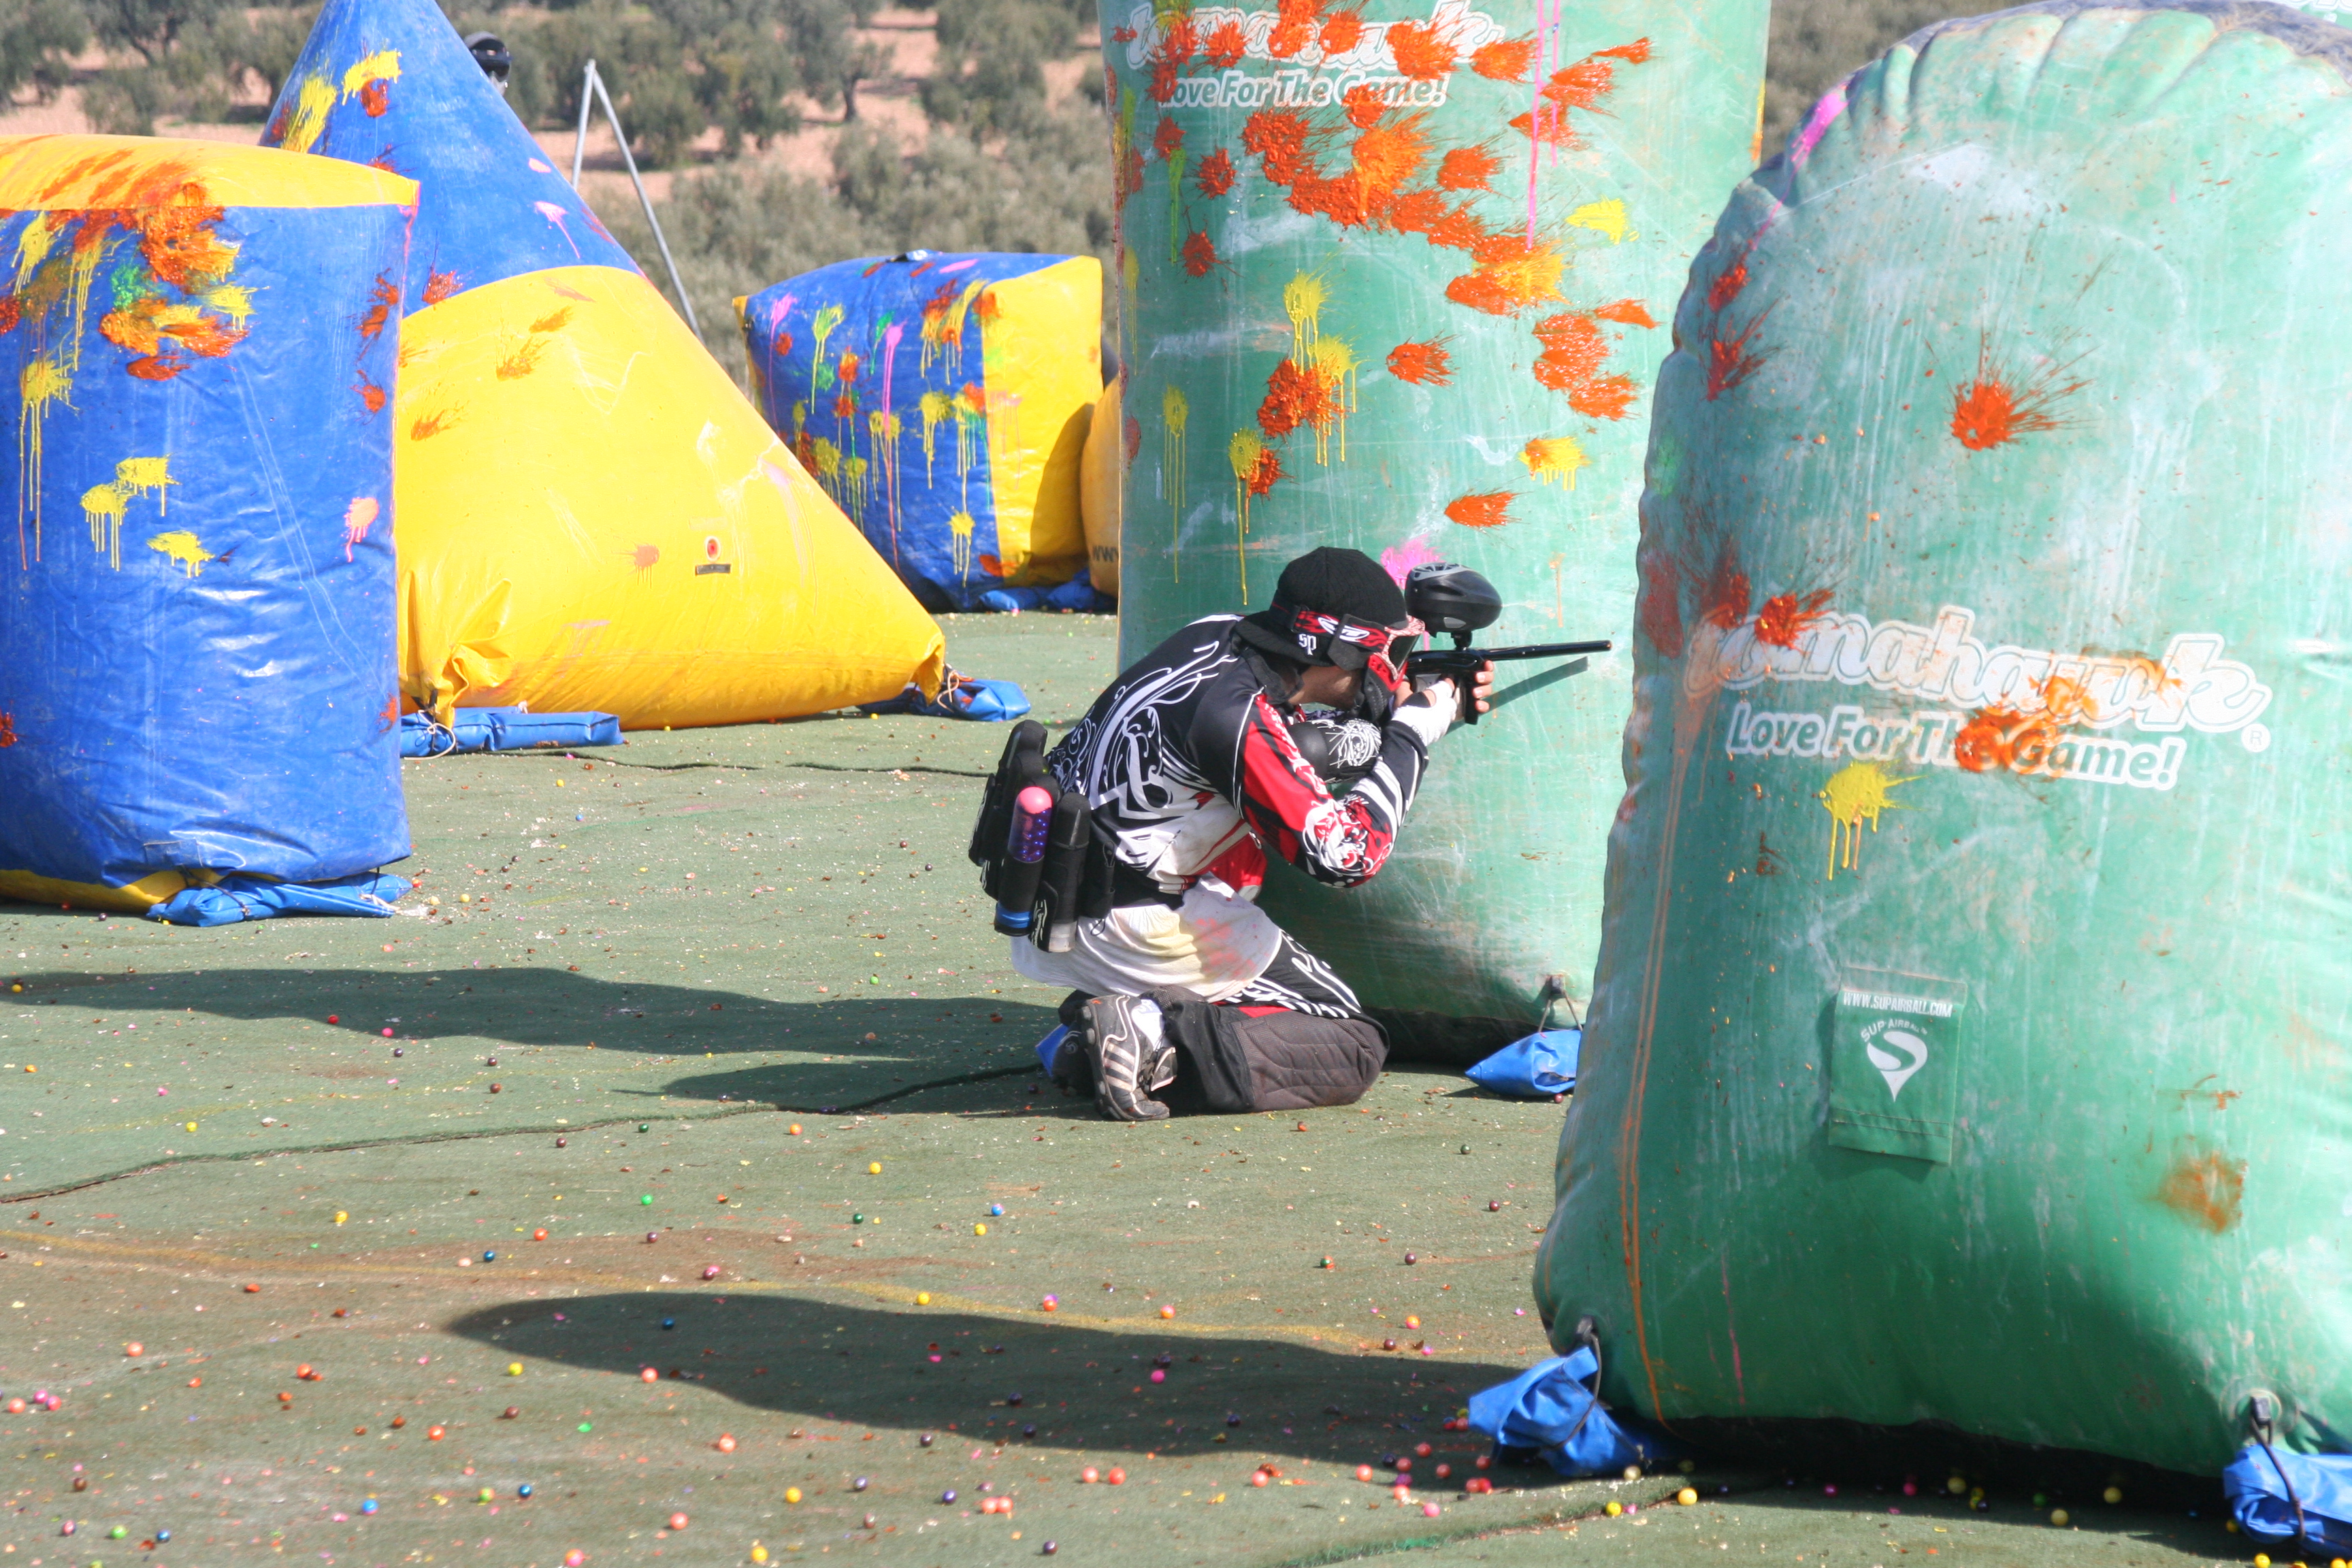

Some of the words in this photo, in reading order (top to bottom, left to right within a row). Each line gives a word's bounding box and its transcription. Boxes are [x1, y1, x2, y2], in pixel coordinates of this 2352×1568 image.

[1126, 0, 1506, 70] tomawk
[1158, 71, 1220, 108] ove
[1217, 70, 1275, 108] For
[1273, 69, 1333, 108] The
[1726, 702, 1825, 757] Love
[1822, 704, 1909, 761] For
[2005, 719, 2187, 790] Game!
[1843, 992, 1953, 1017] WWW.SUPAIRBALL.COM
